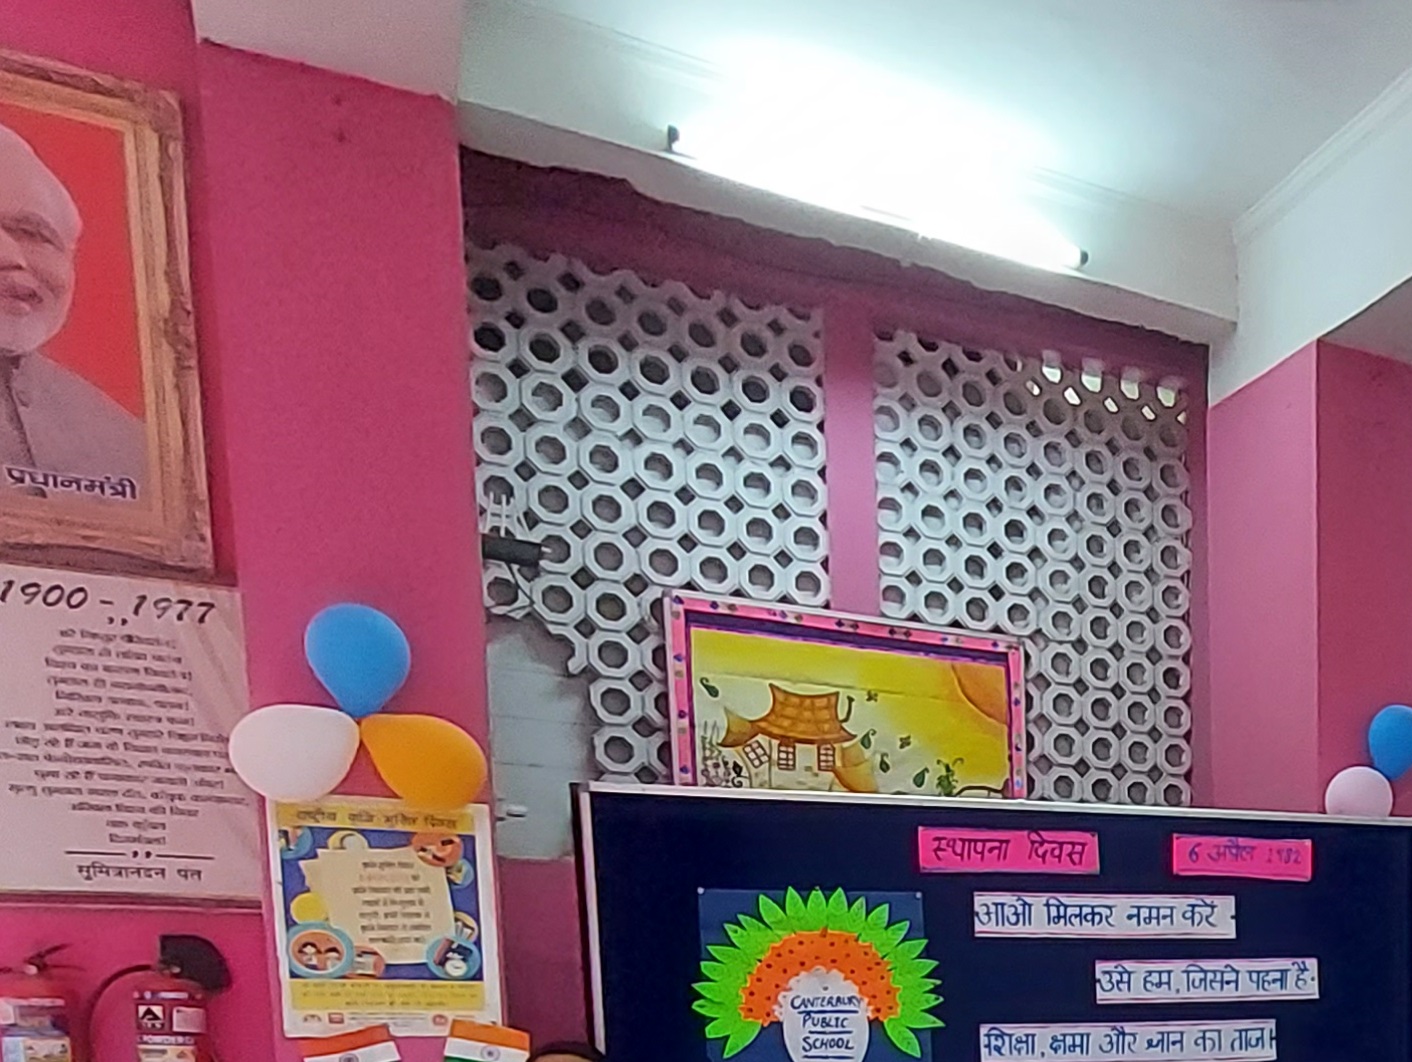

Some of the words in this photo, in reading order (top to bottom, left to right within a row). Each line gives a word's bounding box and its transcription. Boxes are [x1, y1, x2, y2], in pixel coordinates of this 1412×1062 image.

[5, 466, 137, 499] प्रधानमंत्री
[0, 580, 88, 609] 1900
[133, 594, 215, 623] 1977
[932, 836, 1010, 862] स्थापना
[1027, 830, 1088, 866] दिवस
[1188, 842, 1202, 863] 6
[976, 896, 1033, 927] आओ
[1043, 896, 1117, 928] मिलकर
[1126, 904, 1176, 928] नमन
[1181, 898, 1219, 928] करें
[1100, 964, 1136, 992] उसे
[1182, 964, 1241, 992] जिसने
[1247, 968, 1291, 991] पहना
[1292, 961, 1310, 990] है
[790, 995, 861, 1009] CANTERBURY
[802, 1012, 849, 1028] PUBLIC
[802, 1036, 854, 1052] SCHOOL
[1049, 1032, 1091, 1055] क्षमा
[1099, 1025, 1138, 1055] और
[1193, 1028, 1222, 1052] का
